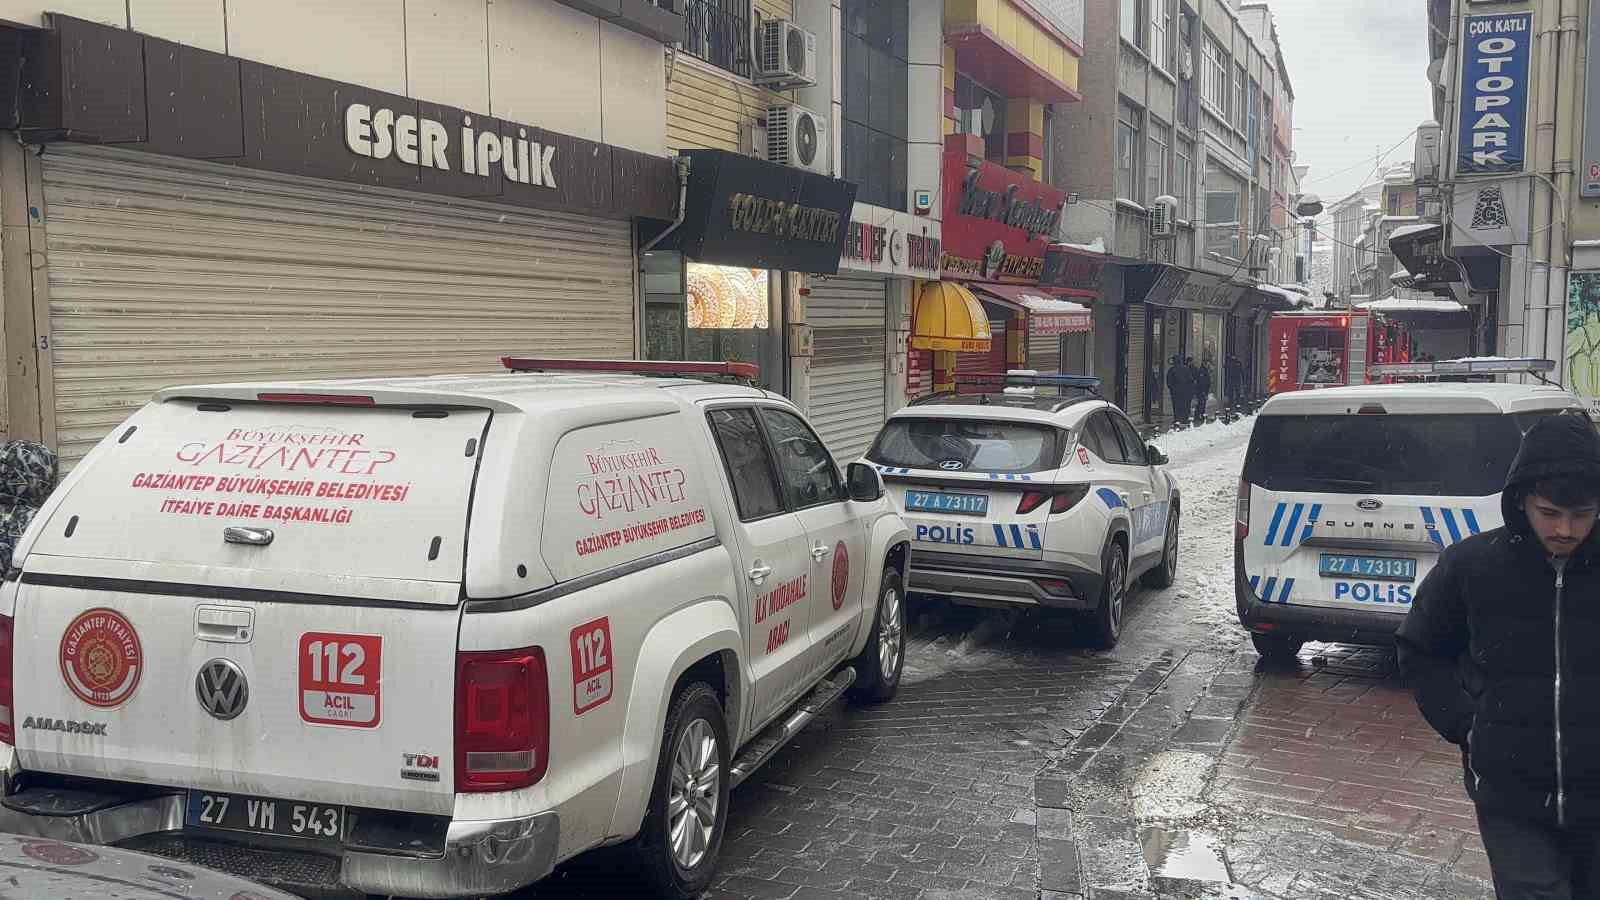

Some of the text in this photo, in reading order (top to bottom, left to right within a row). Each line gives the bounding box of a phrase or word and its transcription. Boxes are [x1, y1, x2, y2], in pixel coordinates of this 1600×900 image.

[1470, 18, 1526, 37] ÇOK KATLI
[1472, 37, 1516, 166] OTOPARK
[346, 103, 557, 189] ESER İPLİK
[176, 442, 396, 475] GAZİANTEP
[132, 472, 411, 502] GAZİANTEP BÜYÜKŞEHİR BELEDİYESİ
[577, 468, 685, 519] GAZİANTEP
[914, 494, 928, 507] 27
[161, 496, 353, 525] İTFAİYE DAİRE BAŞKANLIĞI
[576, 532, 622, 556] GAZİANTEP
[916, 523, 974, 545] POLİS
[1329, 557, 1410, 576] 27 A 73131
[308, 641, 366, 685] 112
[577, 628, 607, 674] 112
[22, 716, 107, 736] AMAROK
[403, 754, 439, 769] TDI
[200, 796, 338, 837] 27 VM 543
